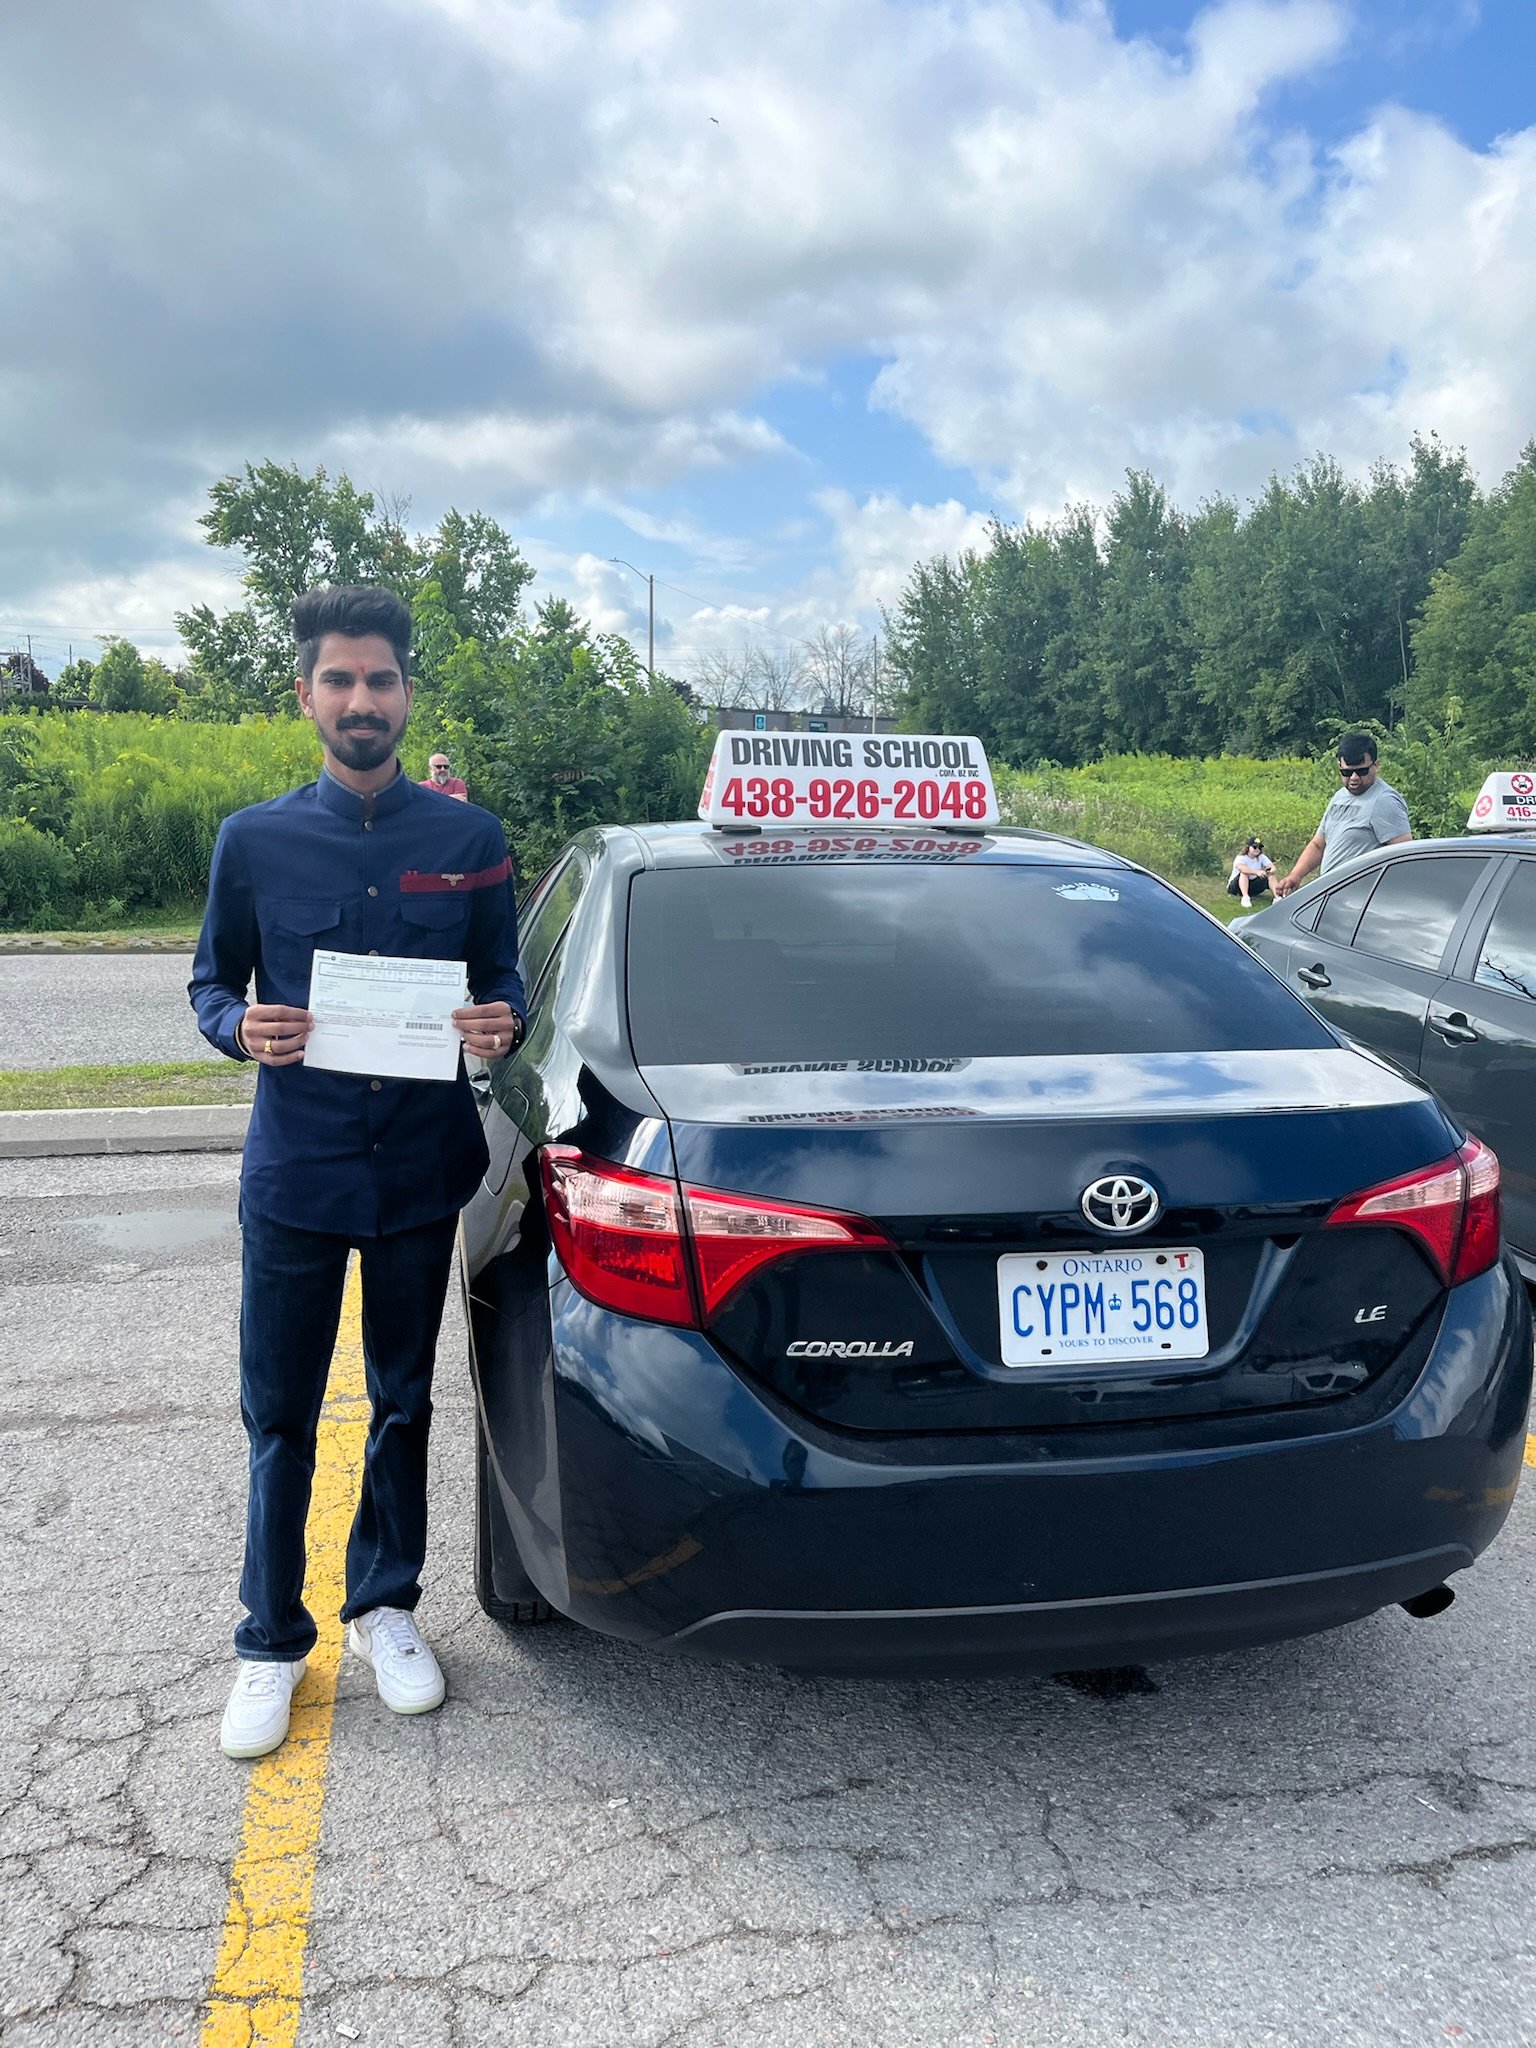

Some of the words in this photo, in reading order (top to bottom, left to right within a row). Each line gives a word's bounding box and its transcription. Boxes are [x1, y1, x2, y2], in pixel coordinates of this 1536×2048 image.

[731, 737, 852, 768] DRIVING
[862, 740, 978, 769] SCHOOL
[721, 777, 987, 820] 438-926-2048
[1063, 1258, 1143, 1276] ONTARIO
[1174, 1253, 1189, 1268] T
[1012, 1282, 1105, 1337] CYPM
[1131, 1278, 1199, 1332] 568
[1354, 1304, 1388, 1324] LE
[786, 1341, 914, 1358] COROLLA
[1059, 1339, 1089, 1348] YOURS
[1093, 1338, 1106, 1346] TO
[1108, 1336, 1154, 1345] DISCOVER
